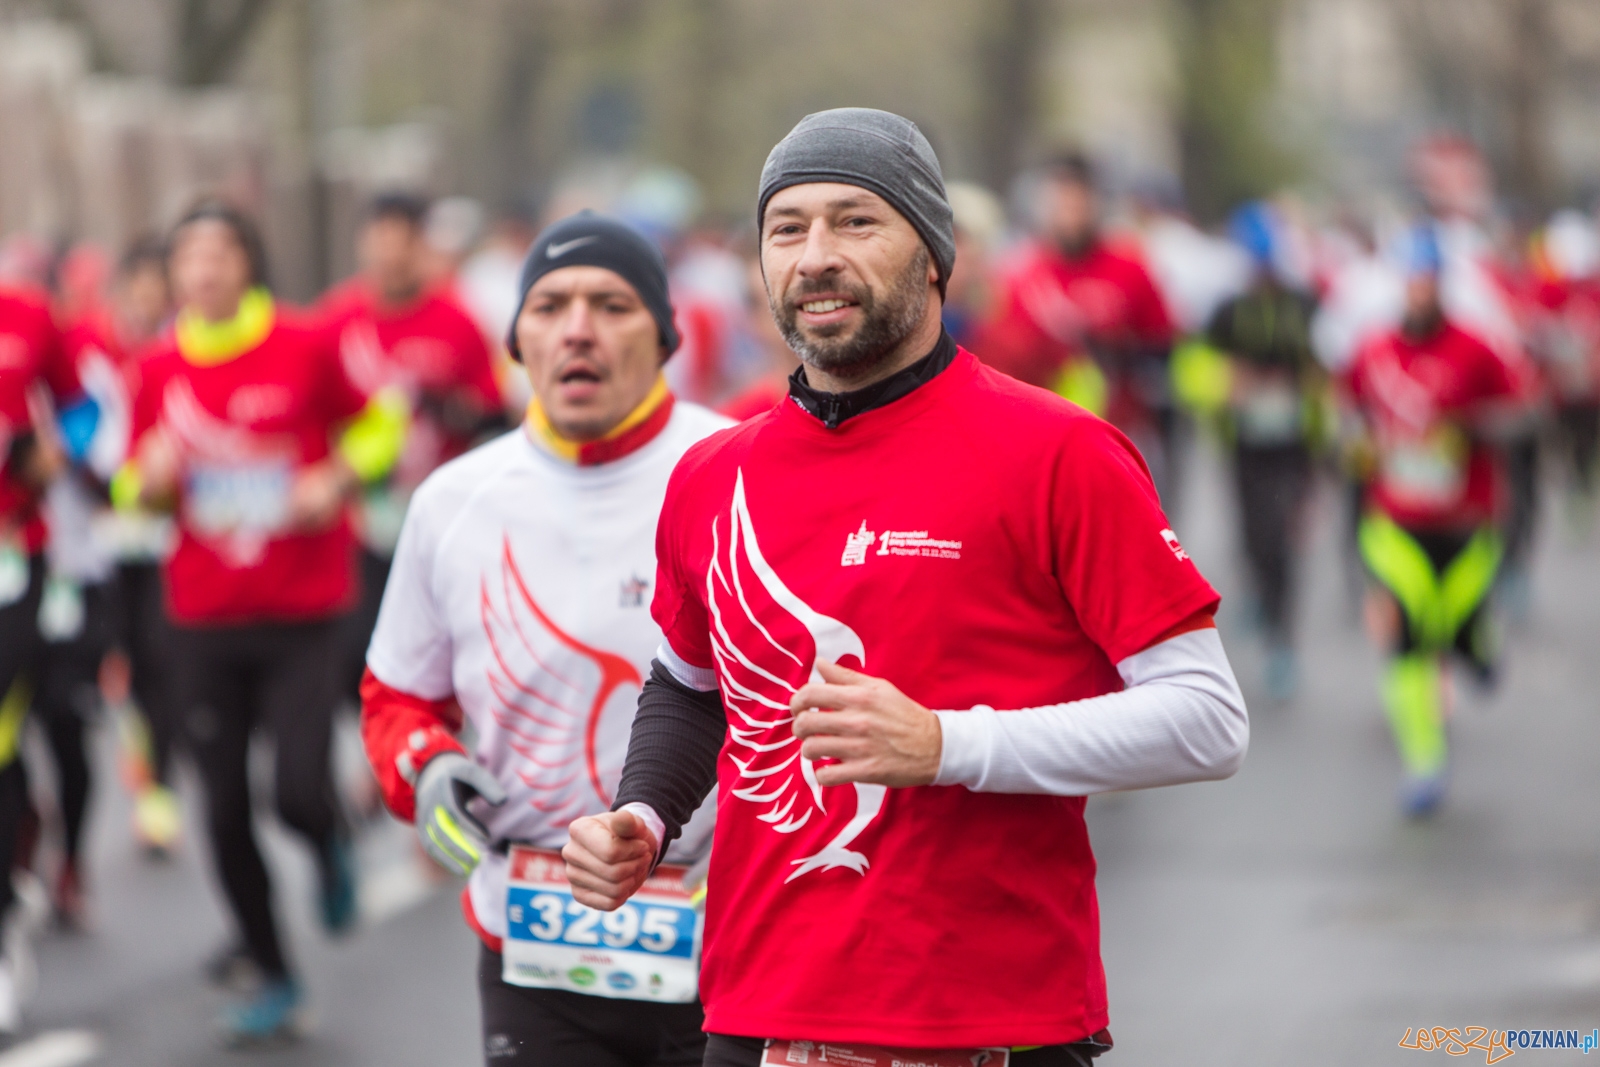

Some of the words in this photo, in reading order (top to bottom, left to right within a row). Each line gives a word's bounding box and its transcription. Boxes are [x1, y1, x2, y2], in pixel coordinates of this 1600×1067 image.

[876, 530, 891, 556] 1
[509, 904, 524, 923] E
[528, 893, 680, 953] 3295
[818, 1044, 828, 1062] 1
